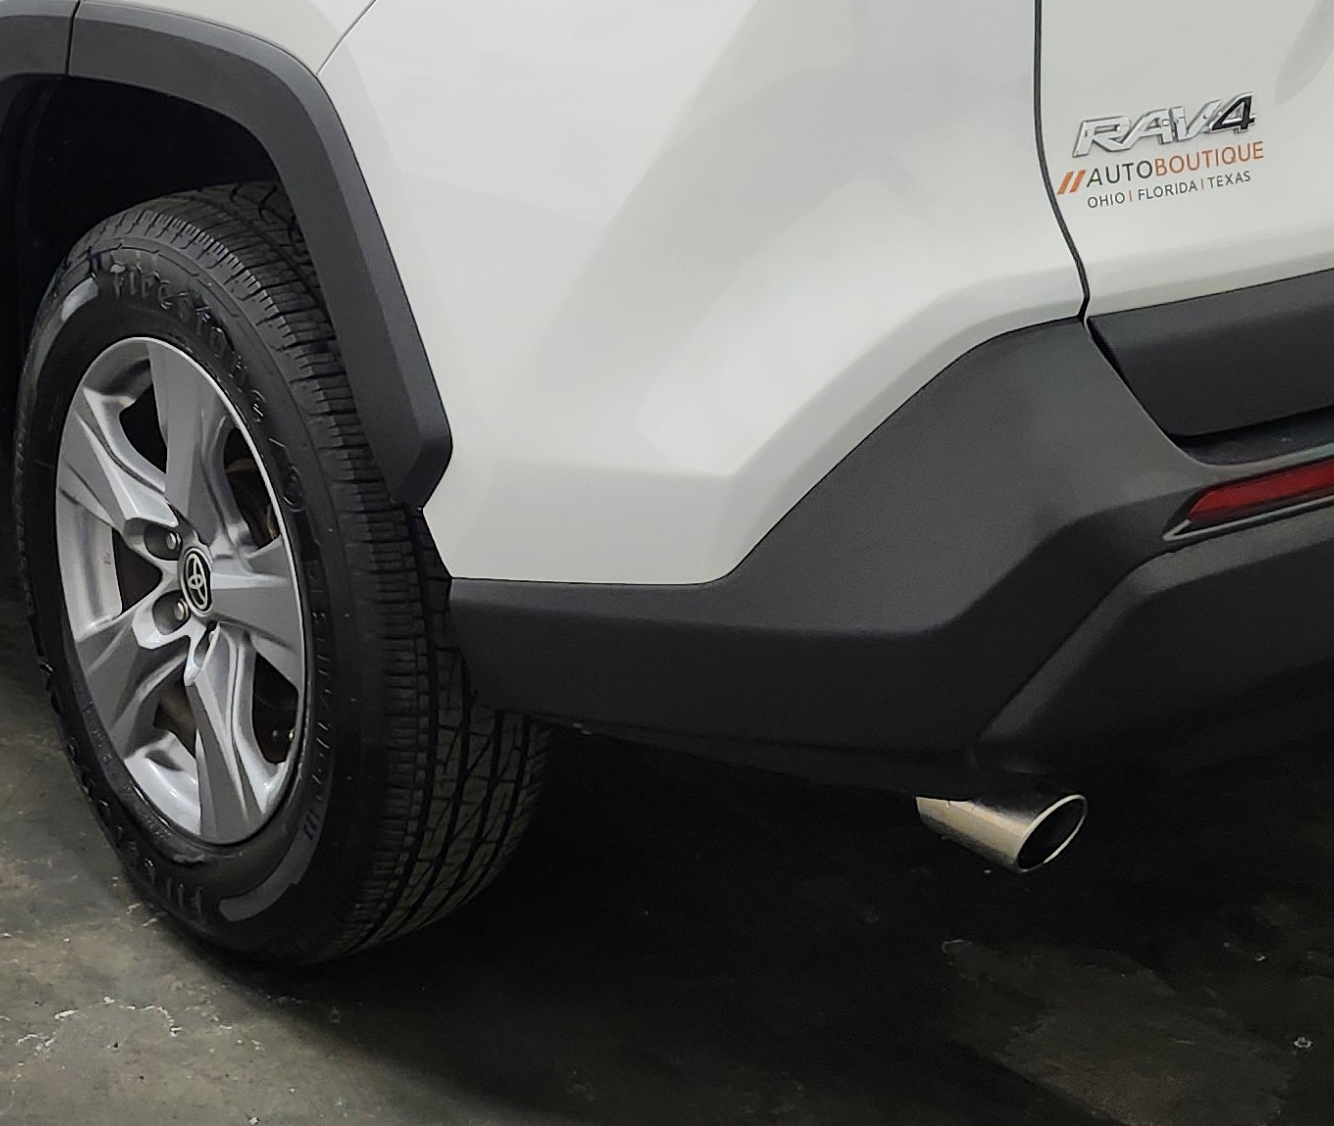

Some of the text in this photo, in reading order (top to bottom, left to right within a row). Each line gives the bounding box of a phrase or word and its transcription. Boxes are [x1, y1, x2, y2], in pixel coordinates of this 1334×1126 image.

[1072, 91, 1257, 158] RAV4
[1086, 141, 1265, 188] AUTOBOUTIQUE
[1087, 170, 1252, 208] OHIO FLORIDA TEXAS
